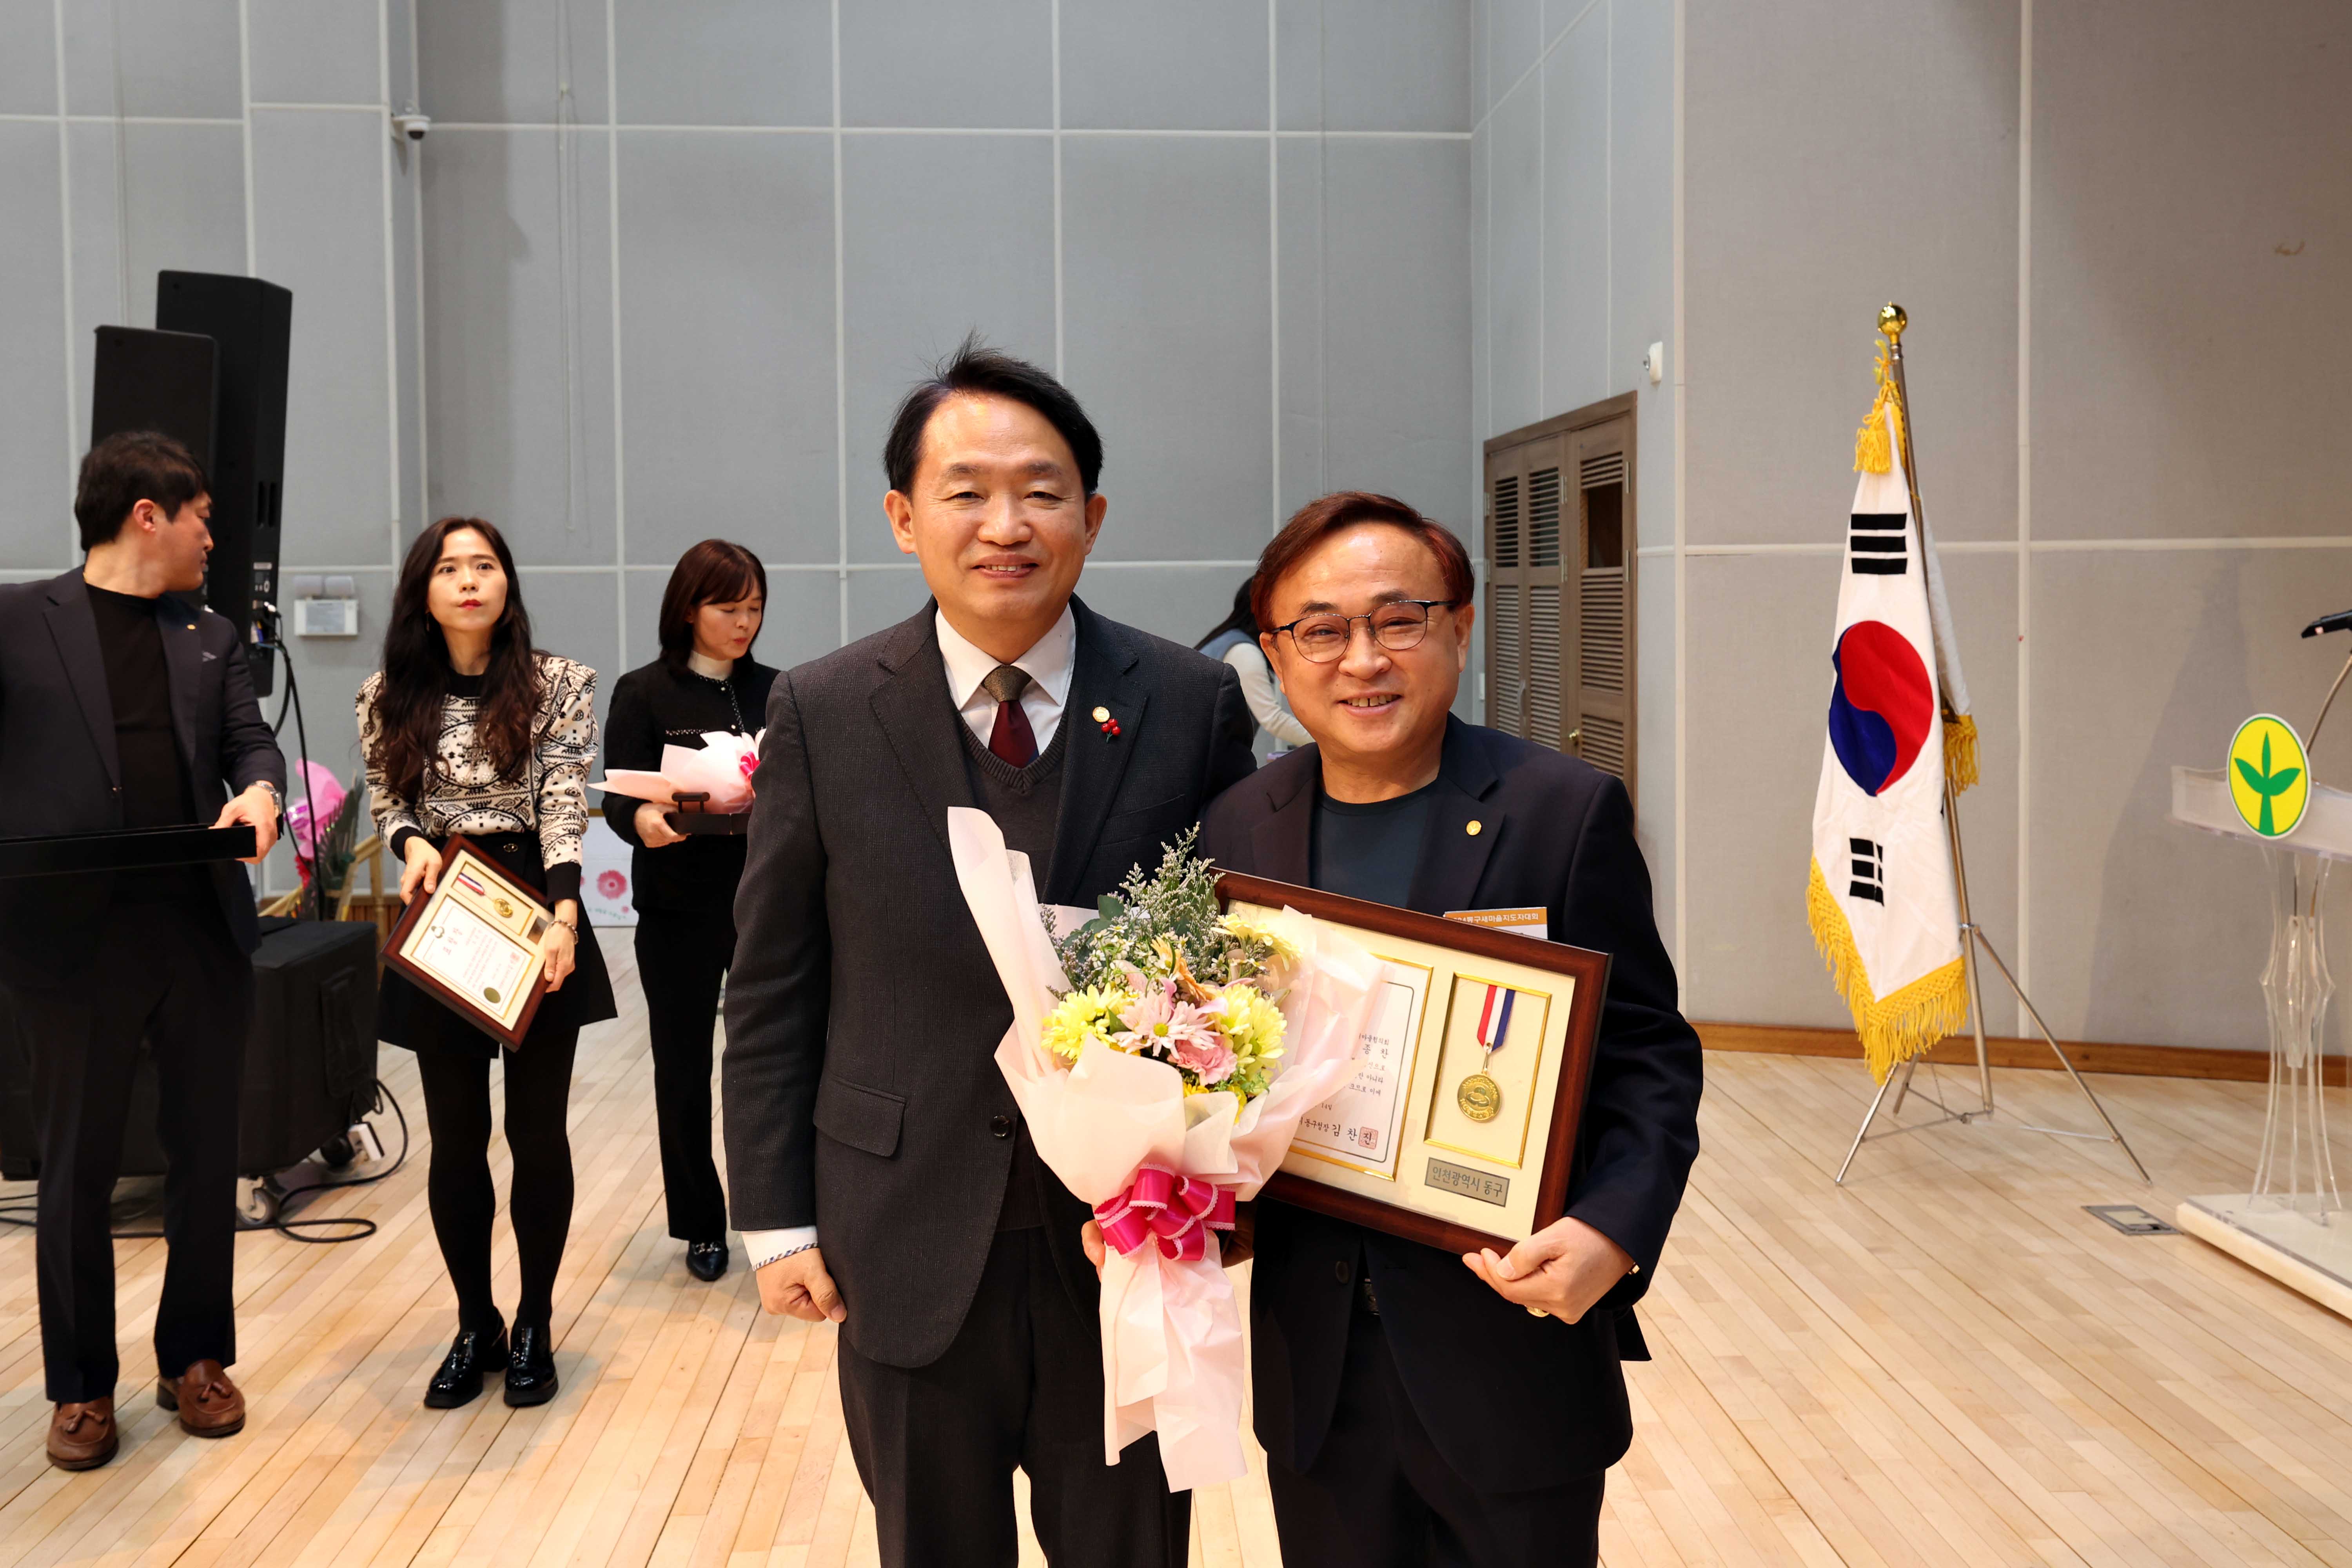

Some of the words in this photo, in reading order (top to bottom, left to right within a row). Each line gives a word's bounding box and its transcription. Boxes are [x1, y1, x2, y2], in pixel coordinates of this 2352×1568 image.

[1359, 1033, 1389, 1045] 마을협의회
[1363, 1044, 1371, 1054] 종
[1381, 1049, 1388, 1058] 찬
[1364, 1062, 1385, 1071] 신으로
[1367, 1074, 1383, 1084] 아니라
[1370, 1088, 1381, 1096] 이에
[1332, 1124, 1341, 1137] 김
[1347, 1128, 1357, 1141] 찬
[1363, 1132, 1372, 1145] 진
[1432, 1167, 1480, 1192] 인천광역시
[1483, 1180, 1503, 1197] 동구
